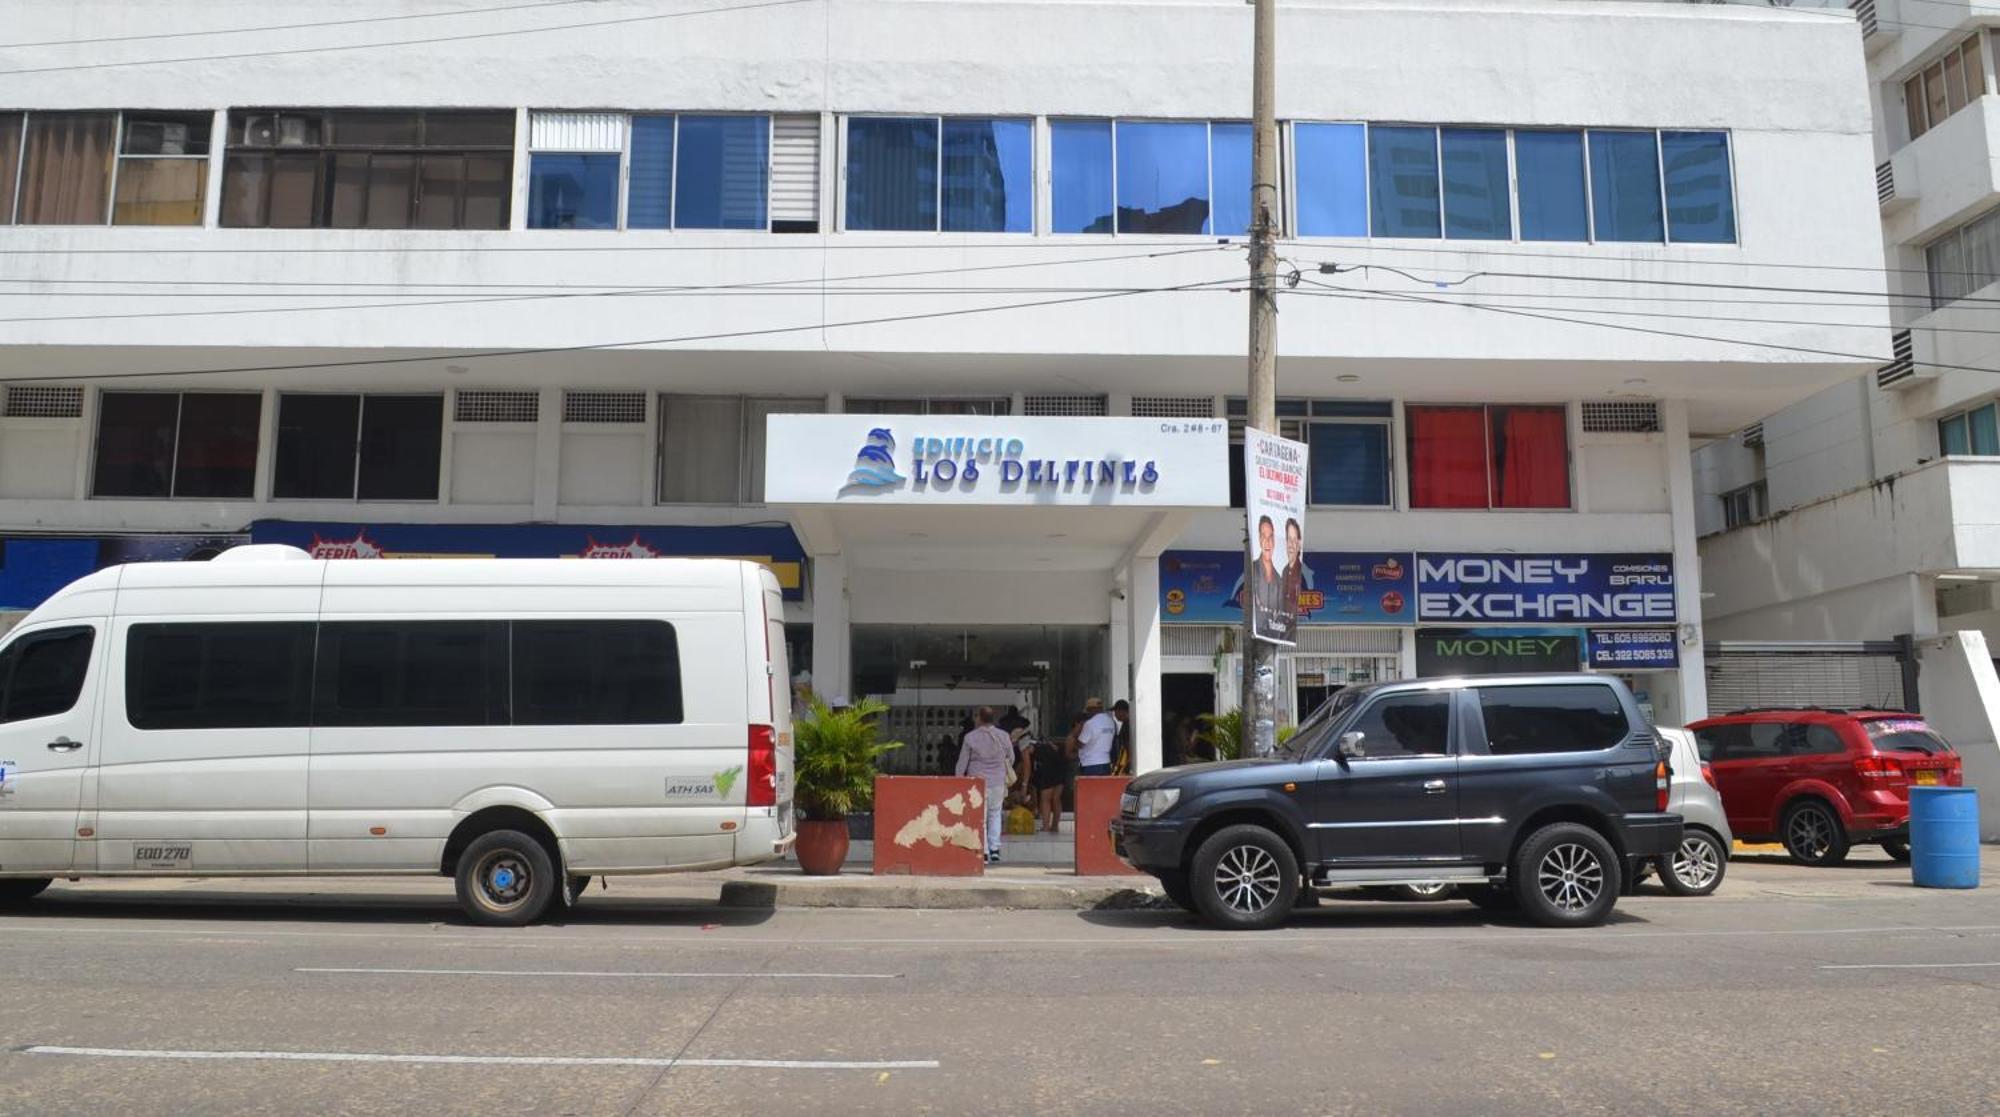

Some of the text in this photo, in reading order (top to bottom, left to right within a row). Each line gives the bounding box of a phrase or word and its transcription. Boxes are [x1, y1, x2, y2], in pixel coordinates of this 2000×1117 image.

[913, 437, 1024, 458] EDIFICIO
[1259, 440, 1298, 463] CARTAGENA
[914, 459, 1159, 484] LOS DELFINES
[1419, 559, 1588, 583] MONEY
[1609, 575, 1673, 585] BARU
[1420, 593, 1674, 617] EXCHANGE
[1436, 639, 1561, 656] MONEY
